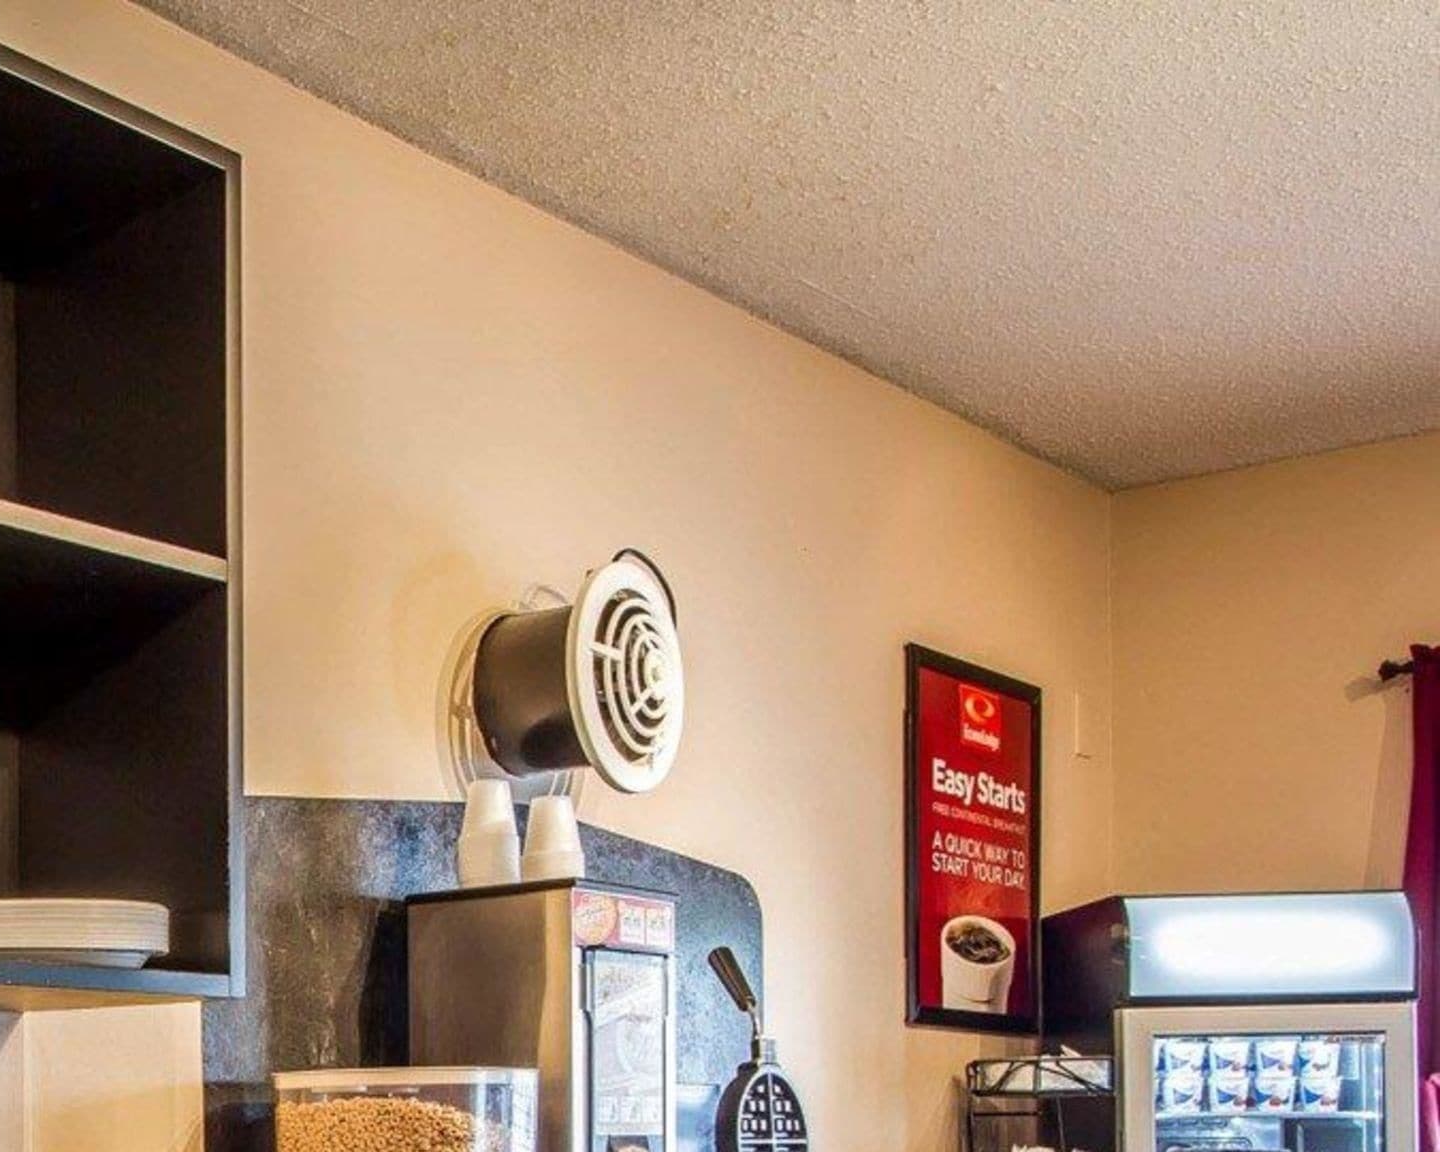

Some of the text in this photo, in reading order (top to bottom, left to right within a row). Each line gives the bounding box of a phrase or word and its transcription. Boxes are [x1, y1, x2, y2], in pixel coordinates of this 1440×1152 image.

[932, 757, 1026, 814] Easy Starts
[932, 830, 1025, 870] A QUICK WAY TO
[932, 852, 970, 878] START
[971, 861, 1003, 884] YOUR
